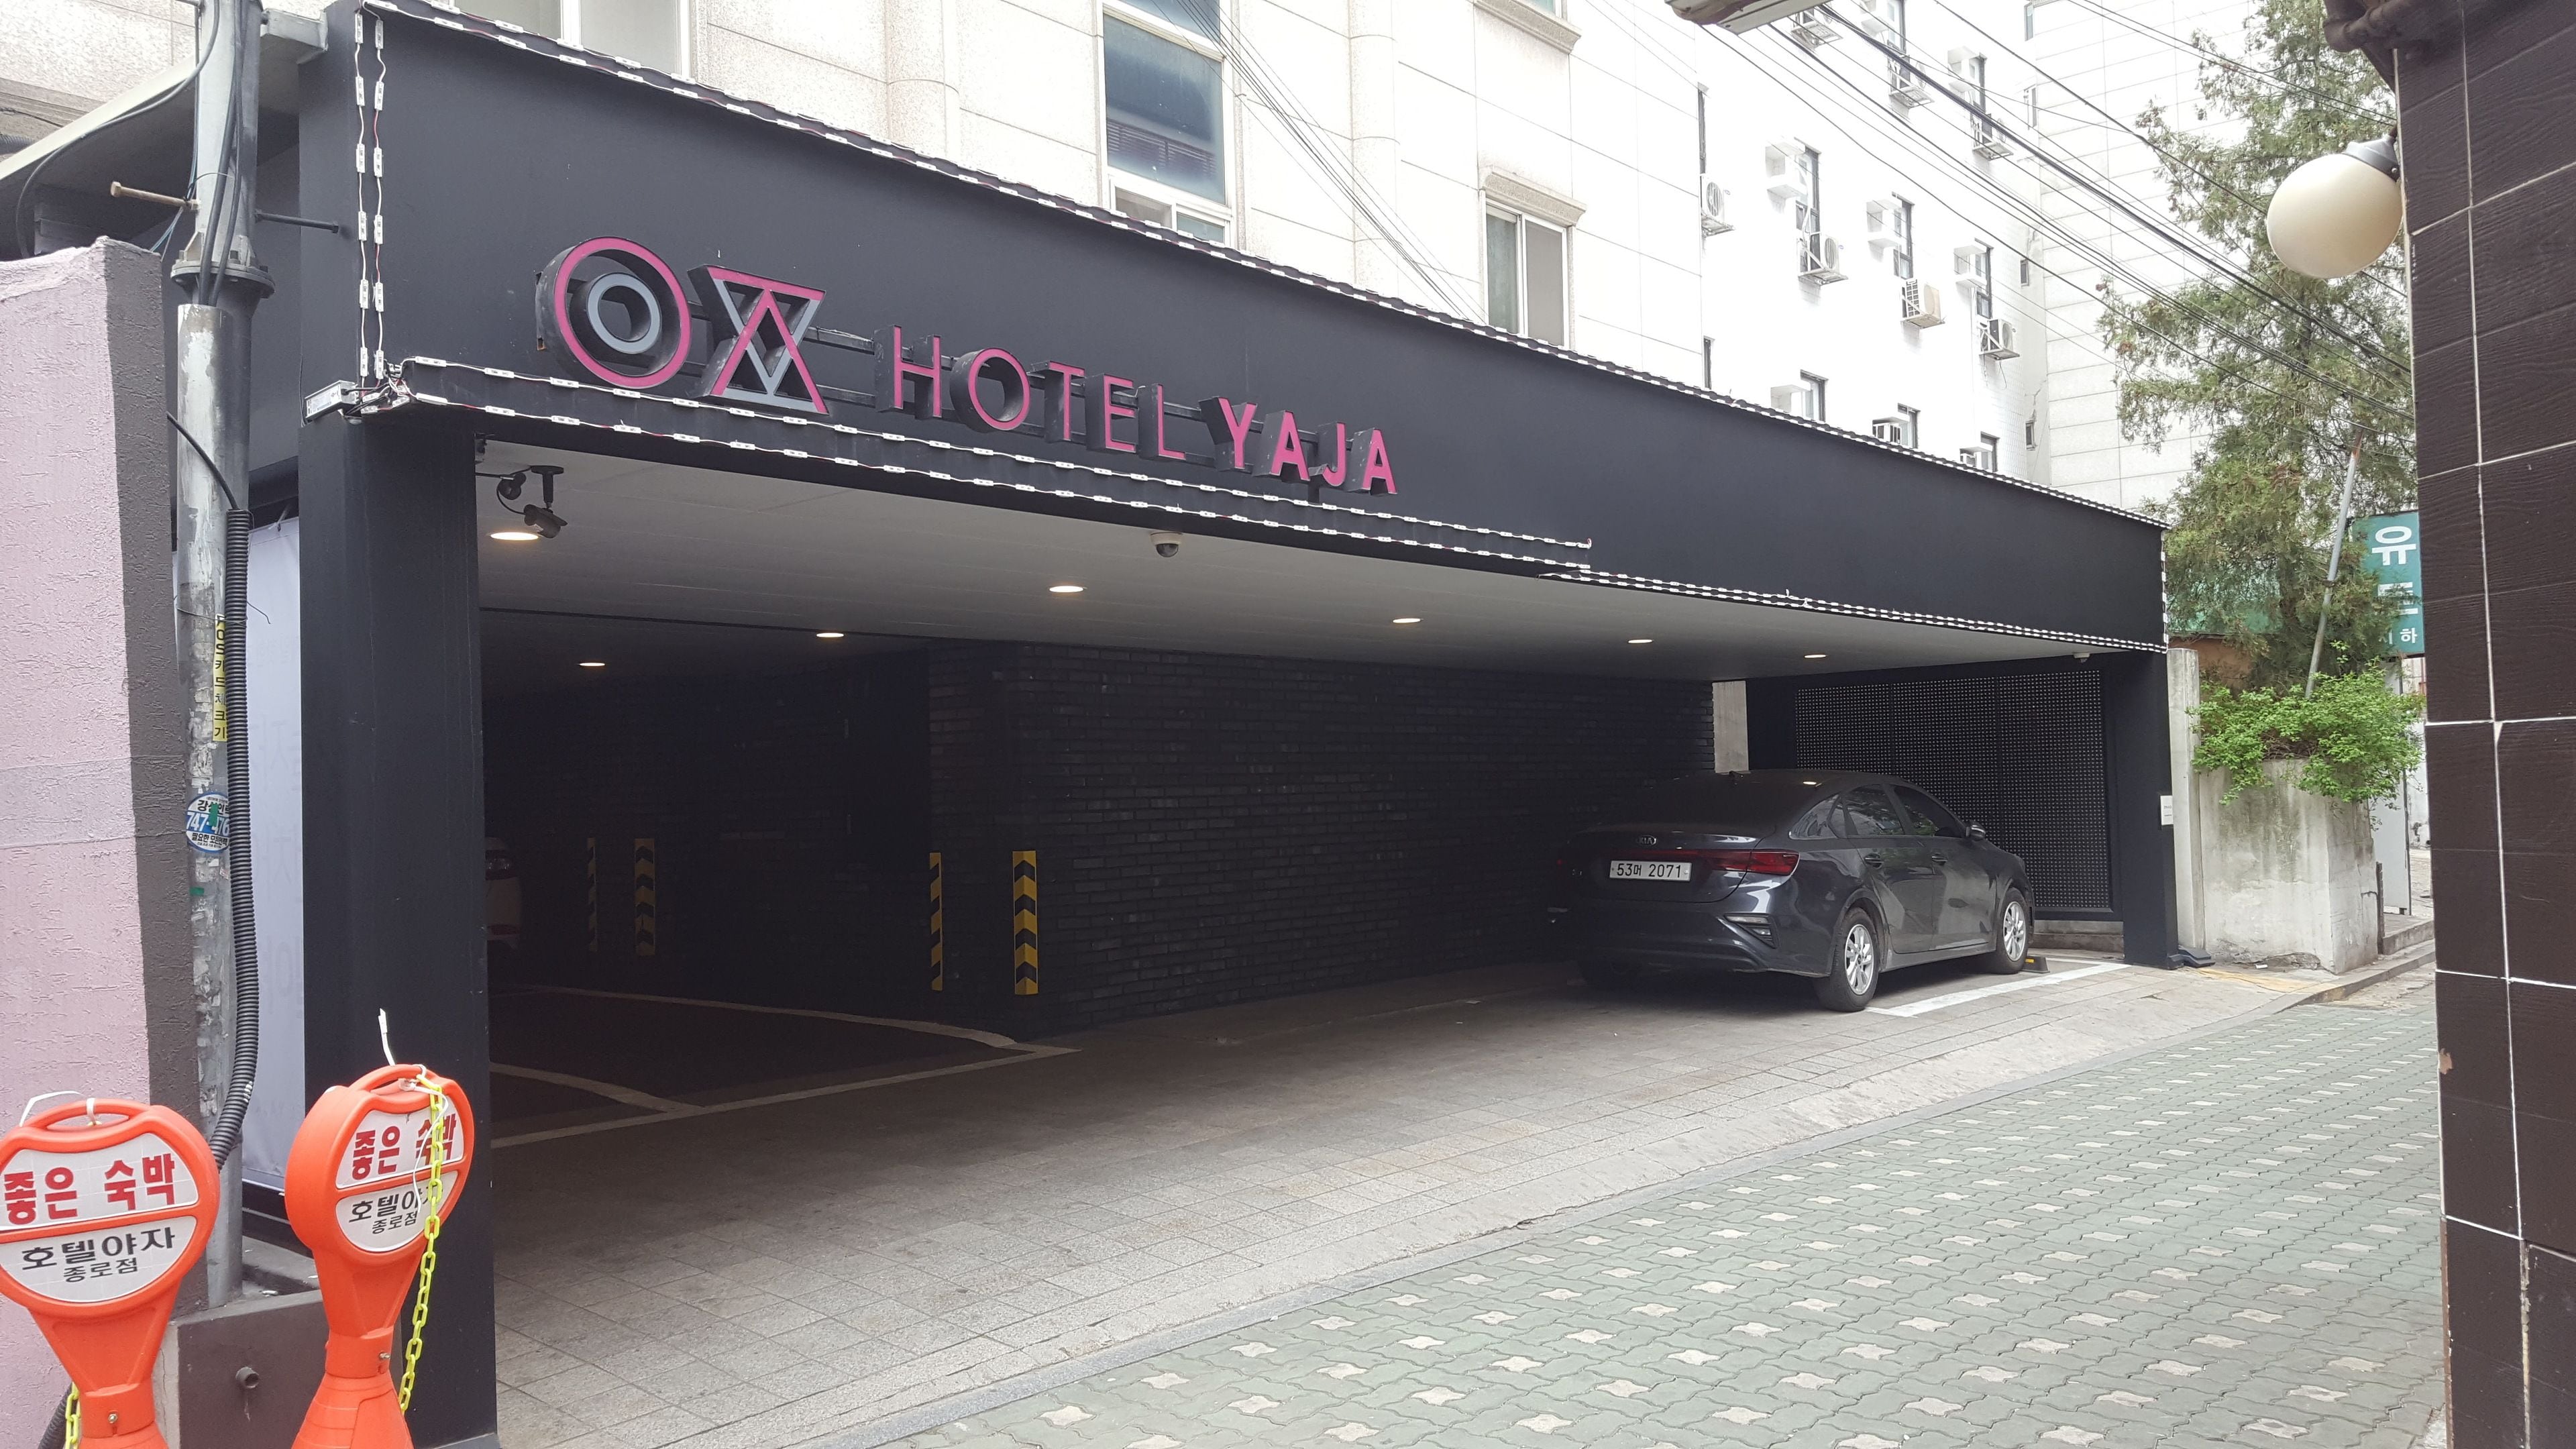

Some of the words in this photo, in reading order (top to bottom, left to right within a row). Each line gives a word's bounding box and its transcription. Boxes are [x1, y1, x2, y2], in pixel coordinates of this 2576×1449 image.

[893, 325, 1186, 460] HOTEL
[1218, 396, 1398, 494] YAJA
[1638, 836, 1654, 845] KIA
[1617, 863, 1642, 876] 53머
[1648, 863, 1682, 878] 2071
[352, 1126, 400, 1180] 좋은
[415, 1114, 457, 1166] 숙박
[4, 1171, 78, 1225] 좋은
[105, 1153, 175, 1210] 숙박
[349, 1185, 443, 1223] 호텔야
[372, 1211, 418, 1234] 종로점
[21, 1227, 175, 1271] 호텔야자
[63, 1258, 138, 1283] 종로점
